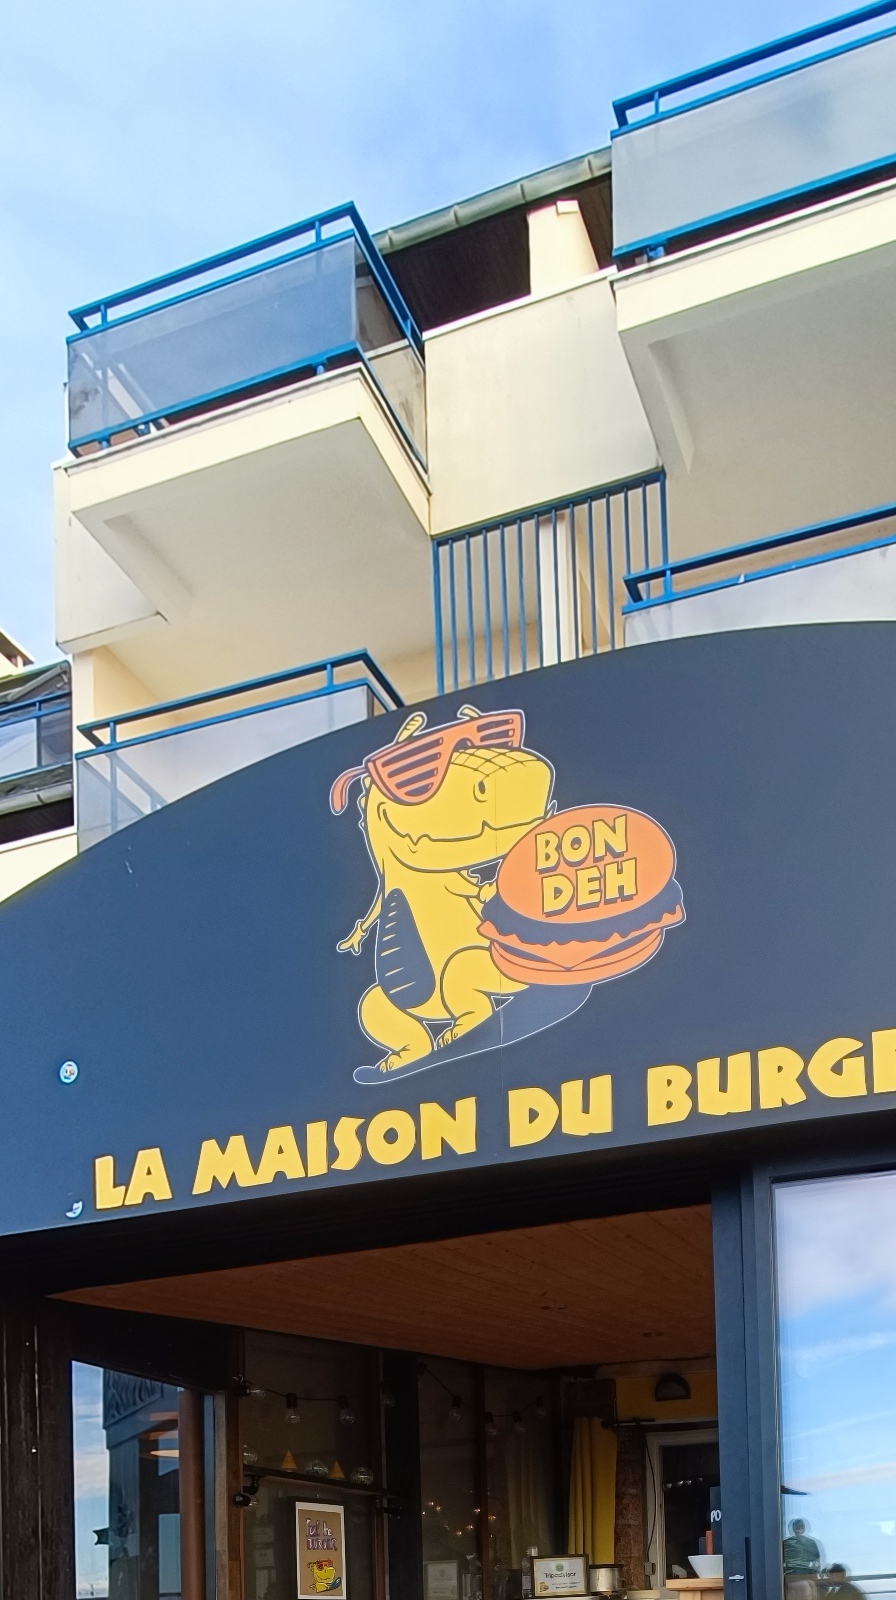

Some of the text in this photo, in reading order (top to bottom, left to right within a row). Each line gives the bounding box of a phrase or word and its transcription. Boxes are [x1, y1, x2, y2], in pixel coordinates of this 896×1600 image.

[535, 813, 628, 875] BON
[541, 857, 638, 918] DEH
[95, 1147, 173, 1210] LA
[192, 1096, 477, 1195] MAISON
[508, 1074, 614, 1148] DU
